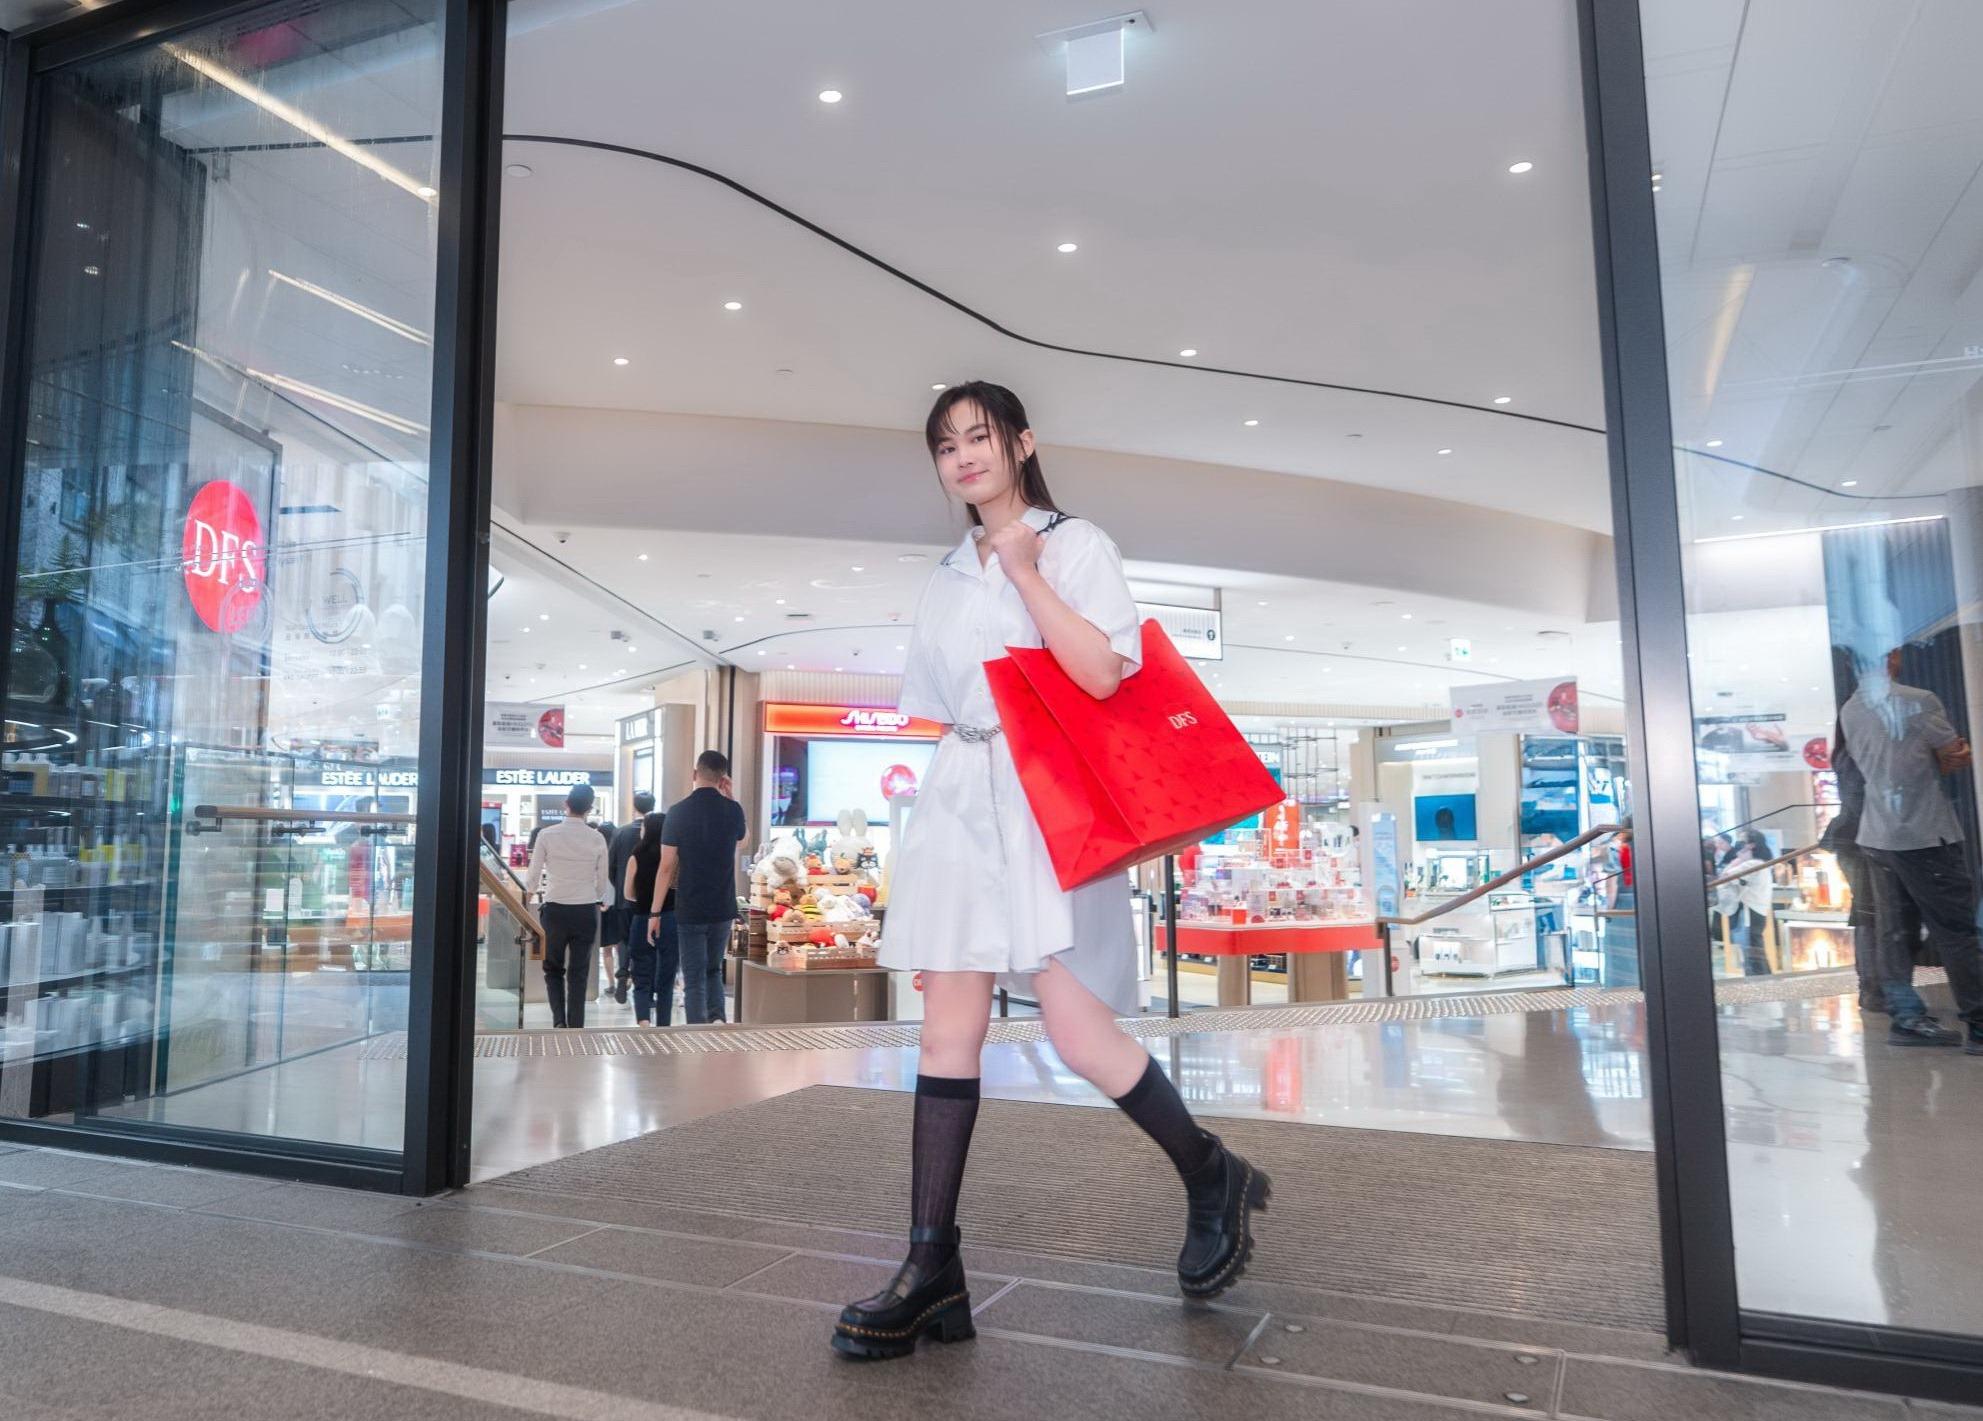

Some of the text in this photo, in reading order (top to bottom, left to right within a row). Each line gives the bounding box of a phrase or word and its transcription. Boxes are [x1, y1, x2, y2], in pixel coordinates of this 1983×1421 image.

[193, 519, 258, 592] DFS
[1167, 711, 1198, 730] DFS
[537, 770, 591, 785] LAUDER
